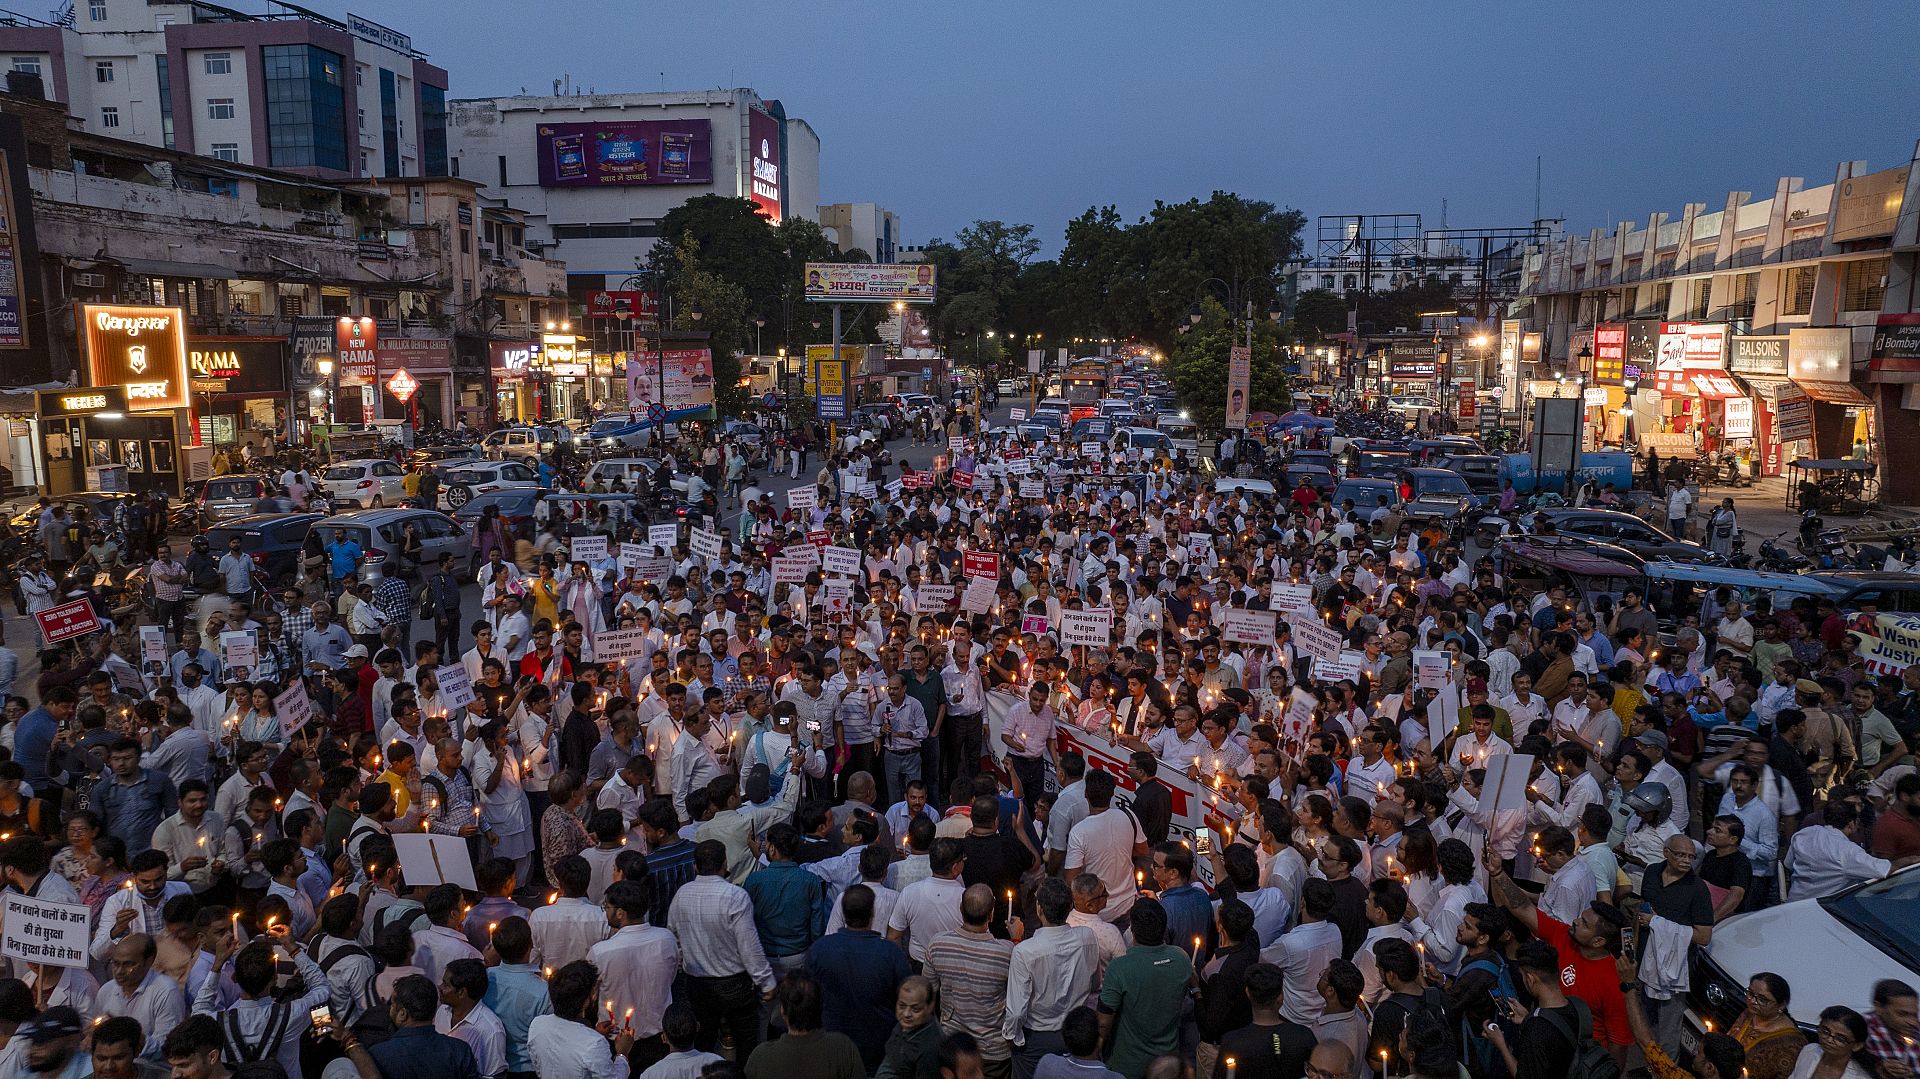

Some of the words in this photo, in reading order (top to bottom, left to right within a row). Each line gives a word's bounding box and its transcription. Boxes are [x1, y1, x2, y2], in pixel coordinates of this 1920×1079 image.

[754, 156, 778, 185] SMART
[754, 180, 778, 200] BAZAAR
[828, 282, 867, 291] अध्यक्ष
[97, 312, 170, 336] Manyavar
[295, 337, 332, 353] FROZEN
[349, 339, 365, 348] NEW
[1885, 337, 1920, 350] Bombay
[190, 351, 240, 373] RAMA
[340, 350, 375, 363] RAMA
[505, 350, 529, 369] VIP
[341, 365, 376, 376] CHEMISTS
[64, 395, 106, 409] TICKETS
[1643, 435, 1692, 446] BALSONS
[57, 605, 85, 617] TOLERANCE
[50, 628, 65, 637] ABUSE
[71, 620, 93, 630] DOCTORS
[1298, 620, 1314, 632] JUSTICE
[1314, 626, 1322, 635] FOR
[1322, 630, 1340, 644] DOCTORS
[1306, 633, 1317, 643] HERE
[1323, 641, 1335, 652] SERVE
[1200, 864, 1214, 884] पर
[9, 902, 21, 913] जान
[22, 905, 40, 917] बचाने
[41, 908, 60, 920] वालों
[60, 909, 68, 921] के
[70, 913, 86, 923] जान
[24, 922, 33, 935] की
[35, 924, 41, 936] हो
[44, 928, 64, 941] सुरक्षा
[7, 936, 21, 951] बिना
[22, 943, 40, 956] सुरक्षा
[42, 944, 56, 957] कैसे
[57, 946, 65, 958] हो
[67, 947, 82, 960] सेवा
